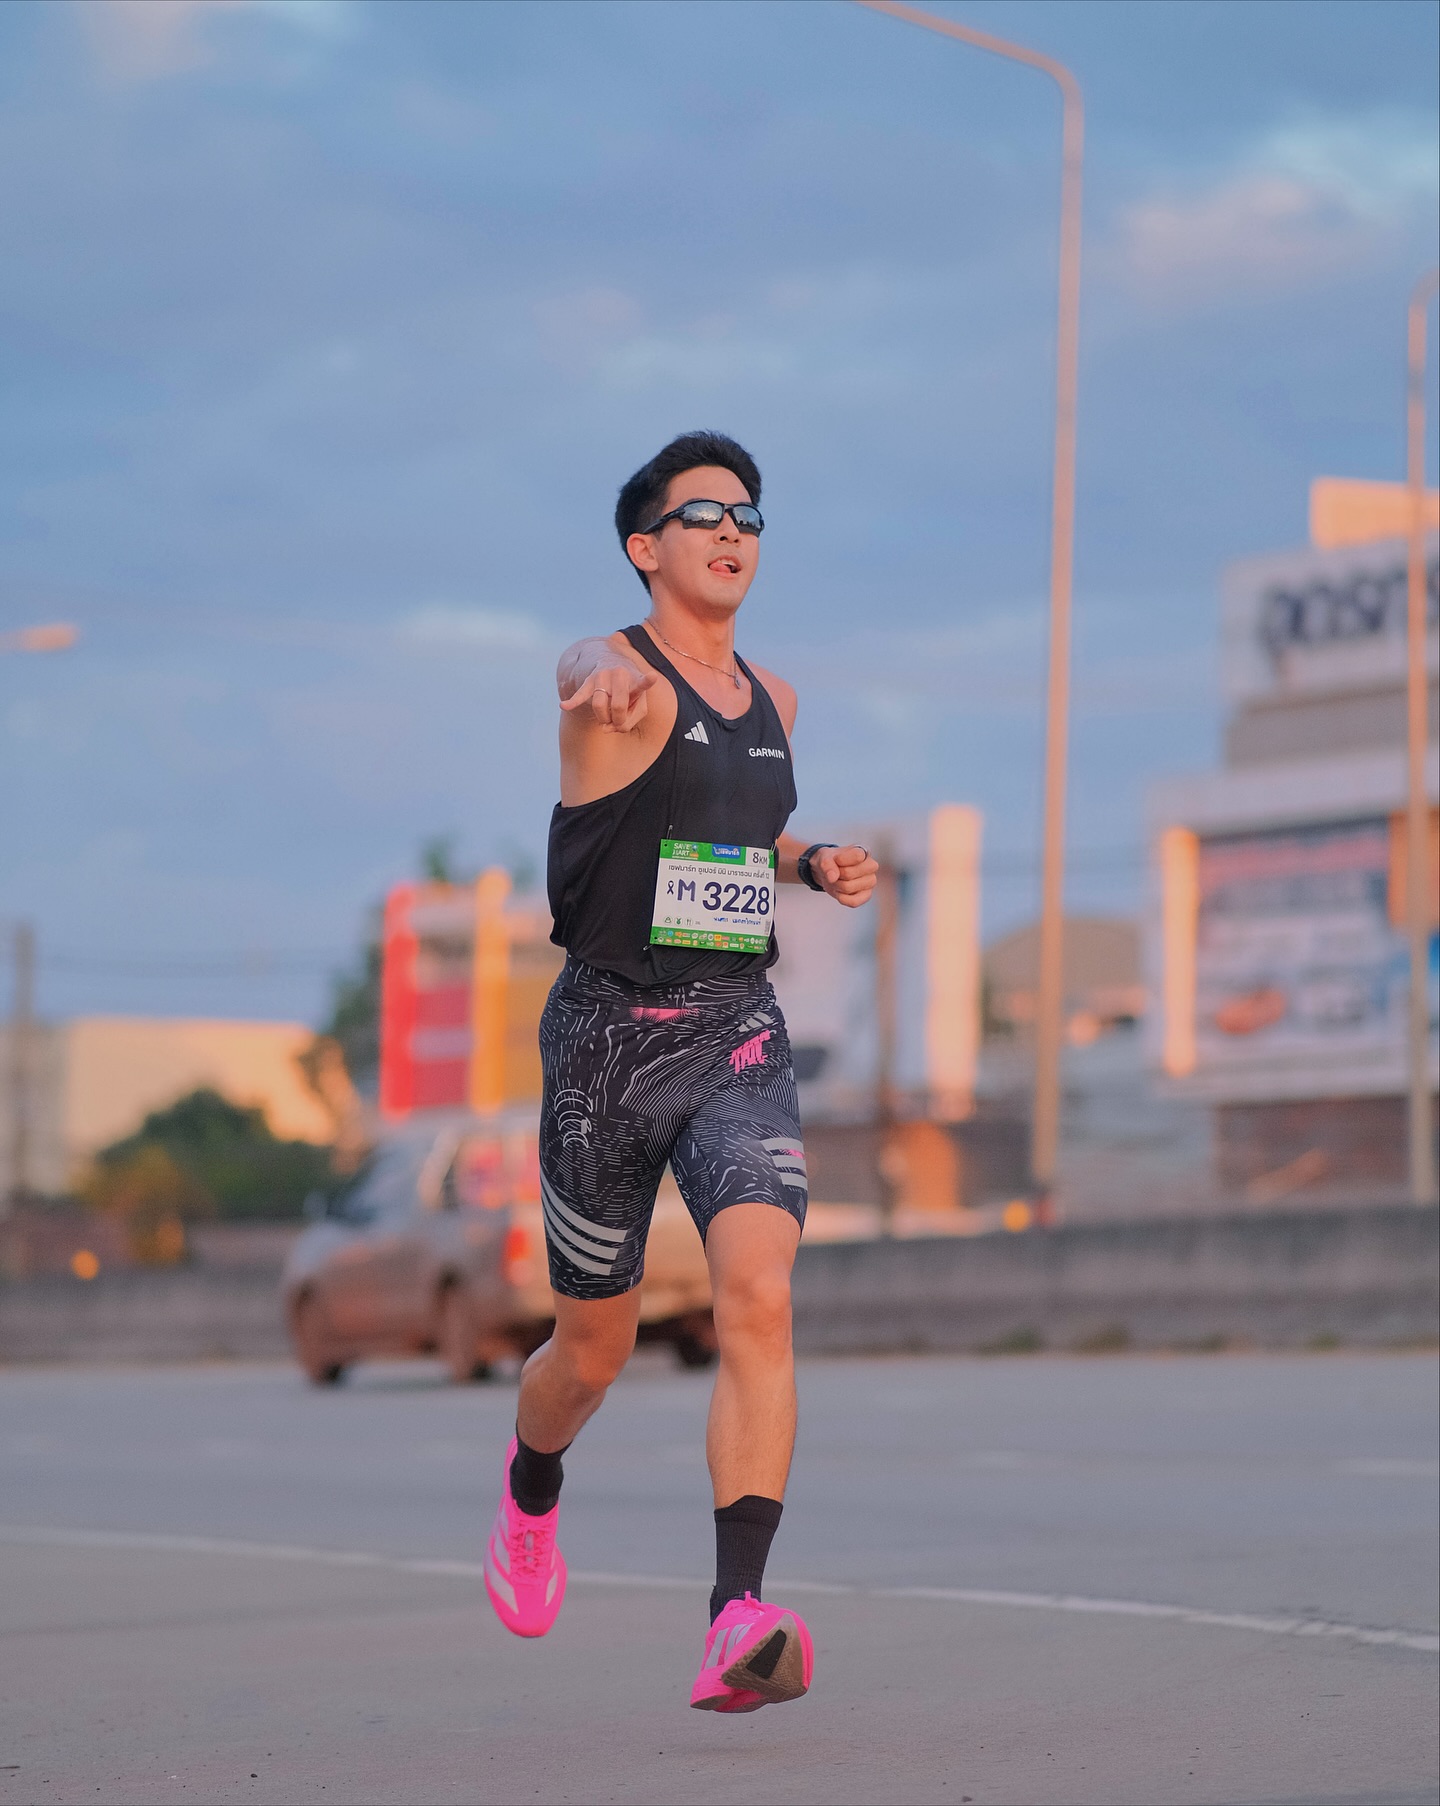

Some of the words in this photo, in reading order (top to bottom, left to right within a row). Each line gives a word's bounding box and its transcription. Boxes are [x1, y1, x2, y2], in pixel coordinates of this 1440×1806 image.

[748, 747, 785, 760] GARMIN
[677, 878, 697, 902] M
[702, 882, 770, 915] 3228
